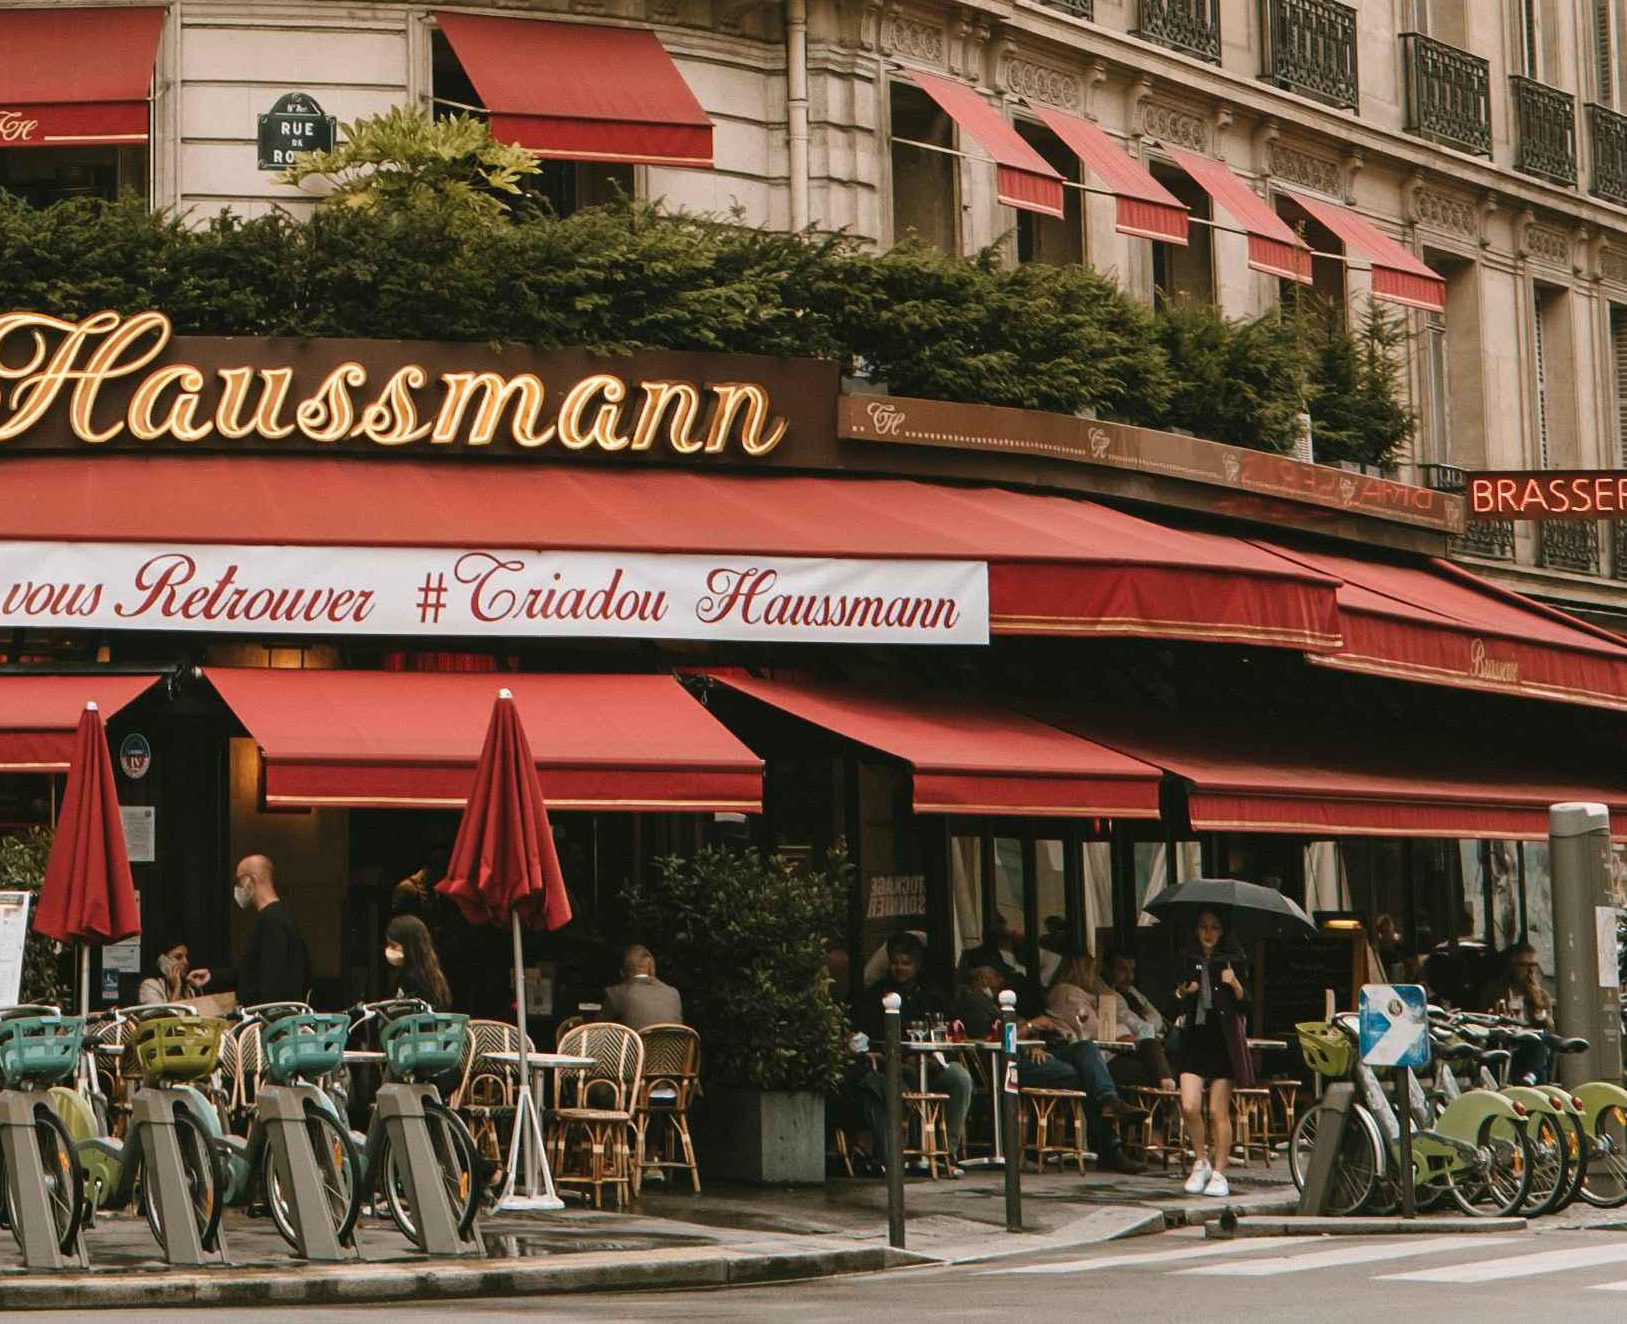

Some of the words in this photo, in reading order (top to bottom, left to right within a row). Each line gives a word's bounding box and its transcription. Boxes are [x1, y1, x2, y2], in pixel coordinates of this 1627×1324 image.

[280, 121, 315, 136] RUE
[291, 138, 304, 148] DE
[1, 580, 103, 618] vous
[114, 552, 376, 623] Retrouver
[695, 566, 962, 630] Haussmann
